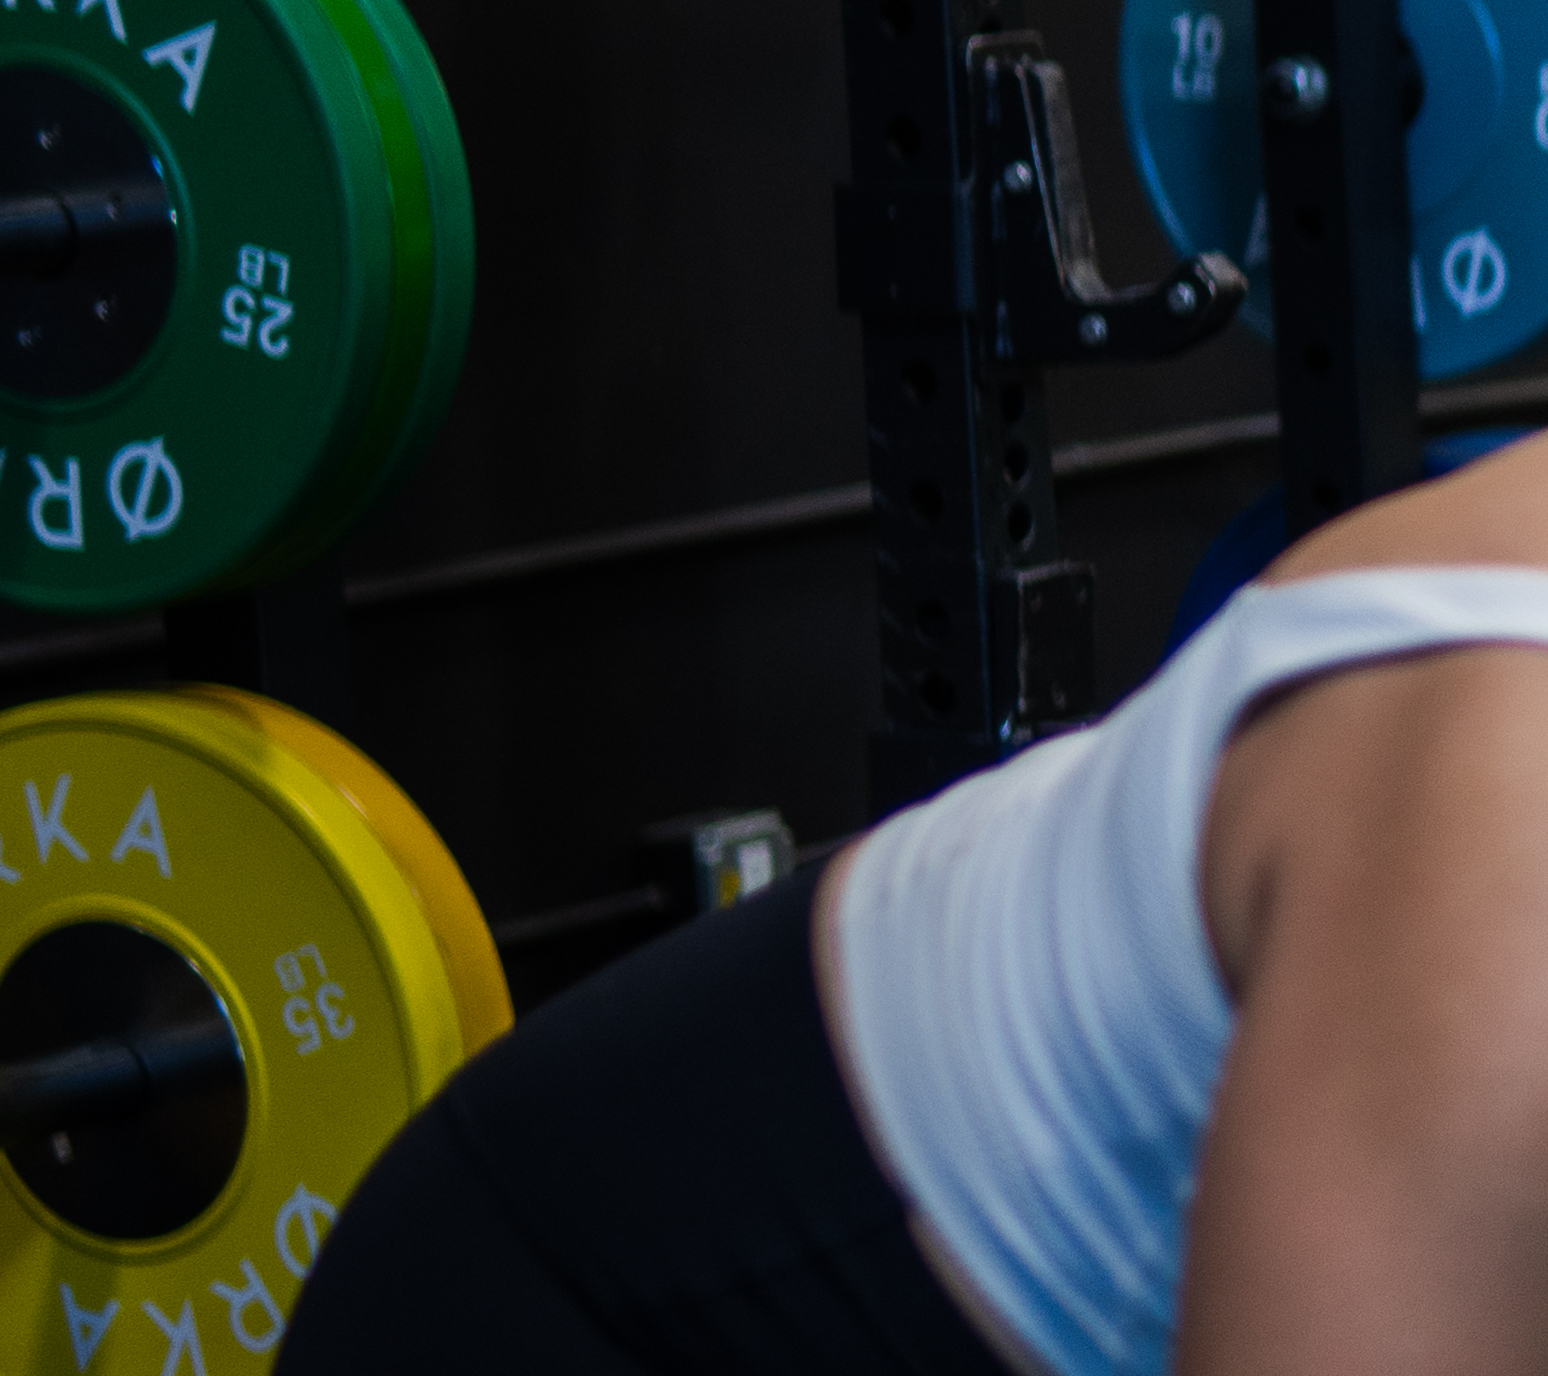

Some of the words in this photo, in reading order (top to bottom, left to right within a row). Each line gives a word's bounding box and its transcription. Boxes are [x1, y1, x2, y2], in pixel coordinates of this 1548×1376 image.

[1171, 11, 1223, 63] 10
[237, 243, 290, 294] LB
[219, 284, 294, 360] 25
[0, 771, 173, 885] KA
[272, 942, 328, 993] LB
[280, 980, 355, 1057] 35
